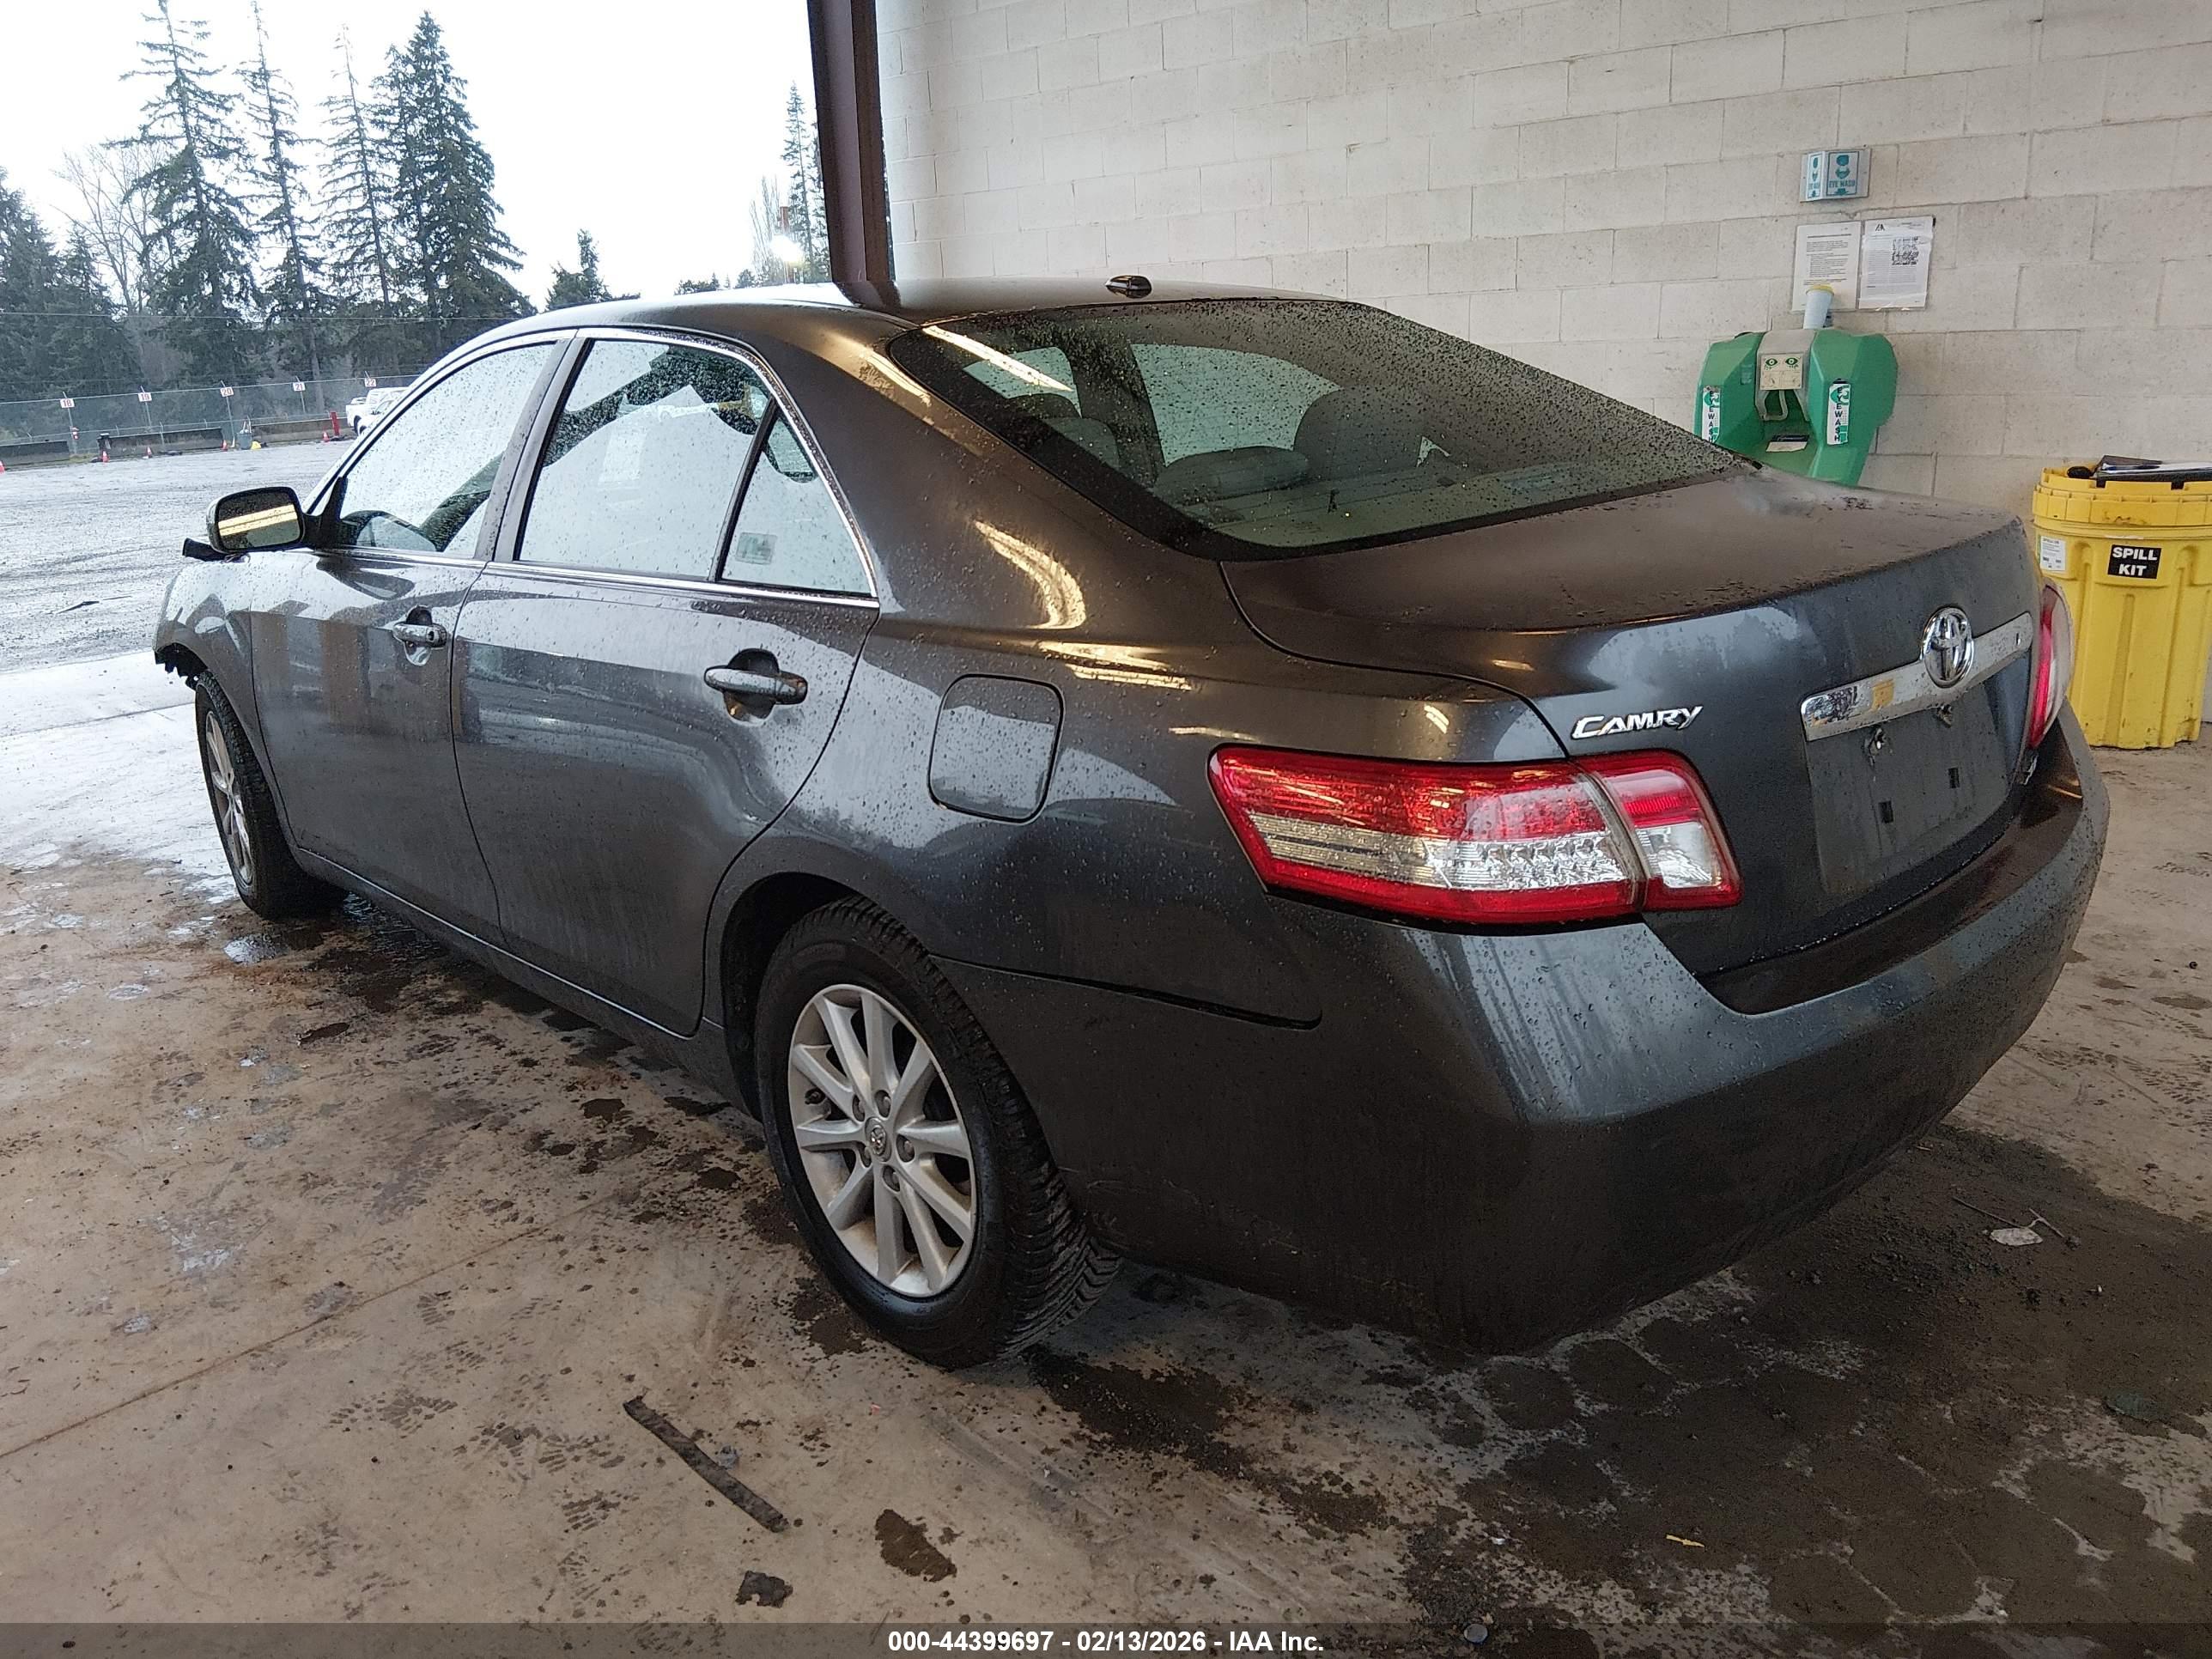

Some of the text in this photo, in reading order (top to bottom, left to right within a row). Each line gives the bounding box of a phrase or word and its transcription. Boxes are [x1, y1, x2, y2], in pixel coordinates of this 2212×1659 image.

[222, 387, 232, 396] 20
[1834, 386, 1843, 441] EYEWASH
[2112, 546, 2158, 561] SPILL
[2118, 563, 2147, 576] KIT
[1572, 705, 1704, 739] CAMRY
